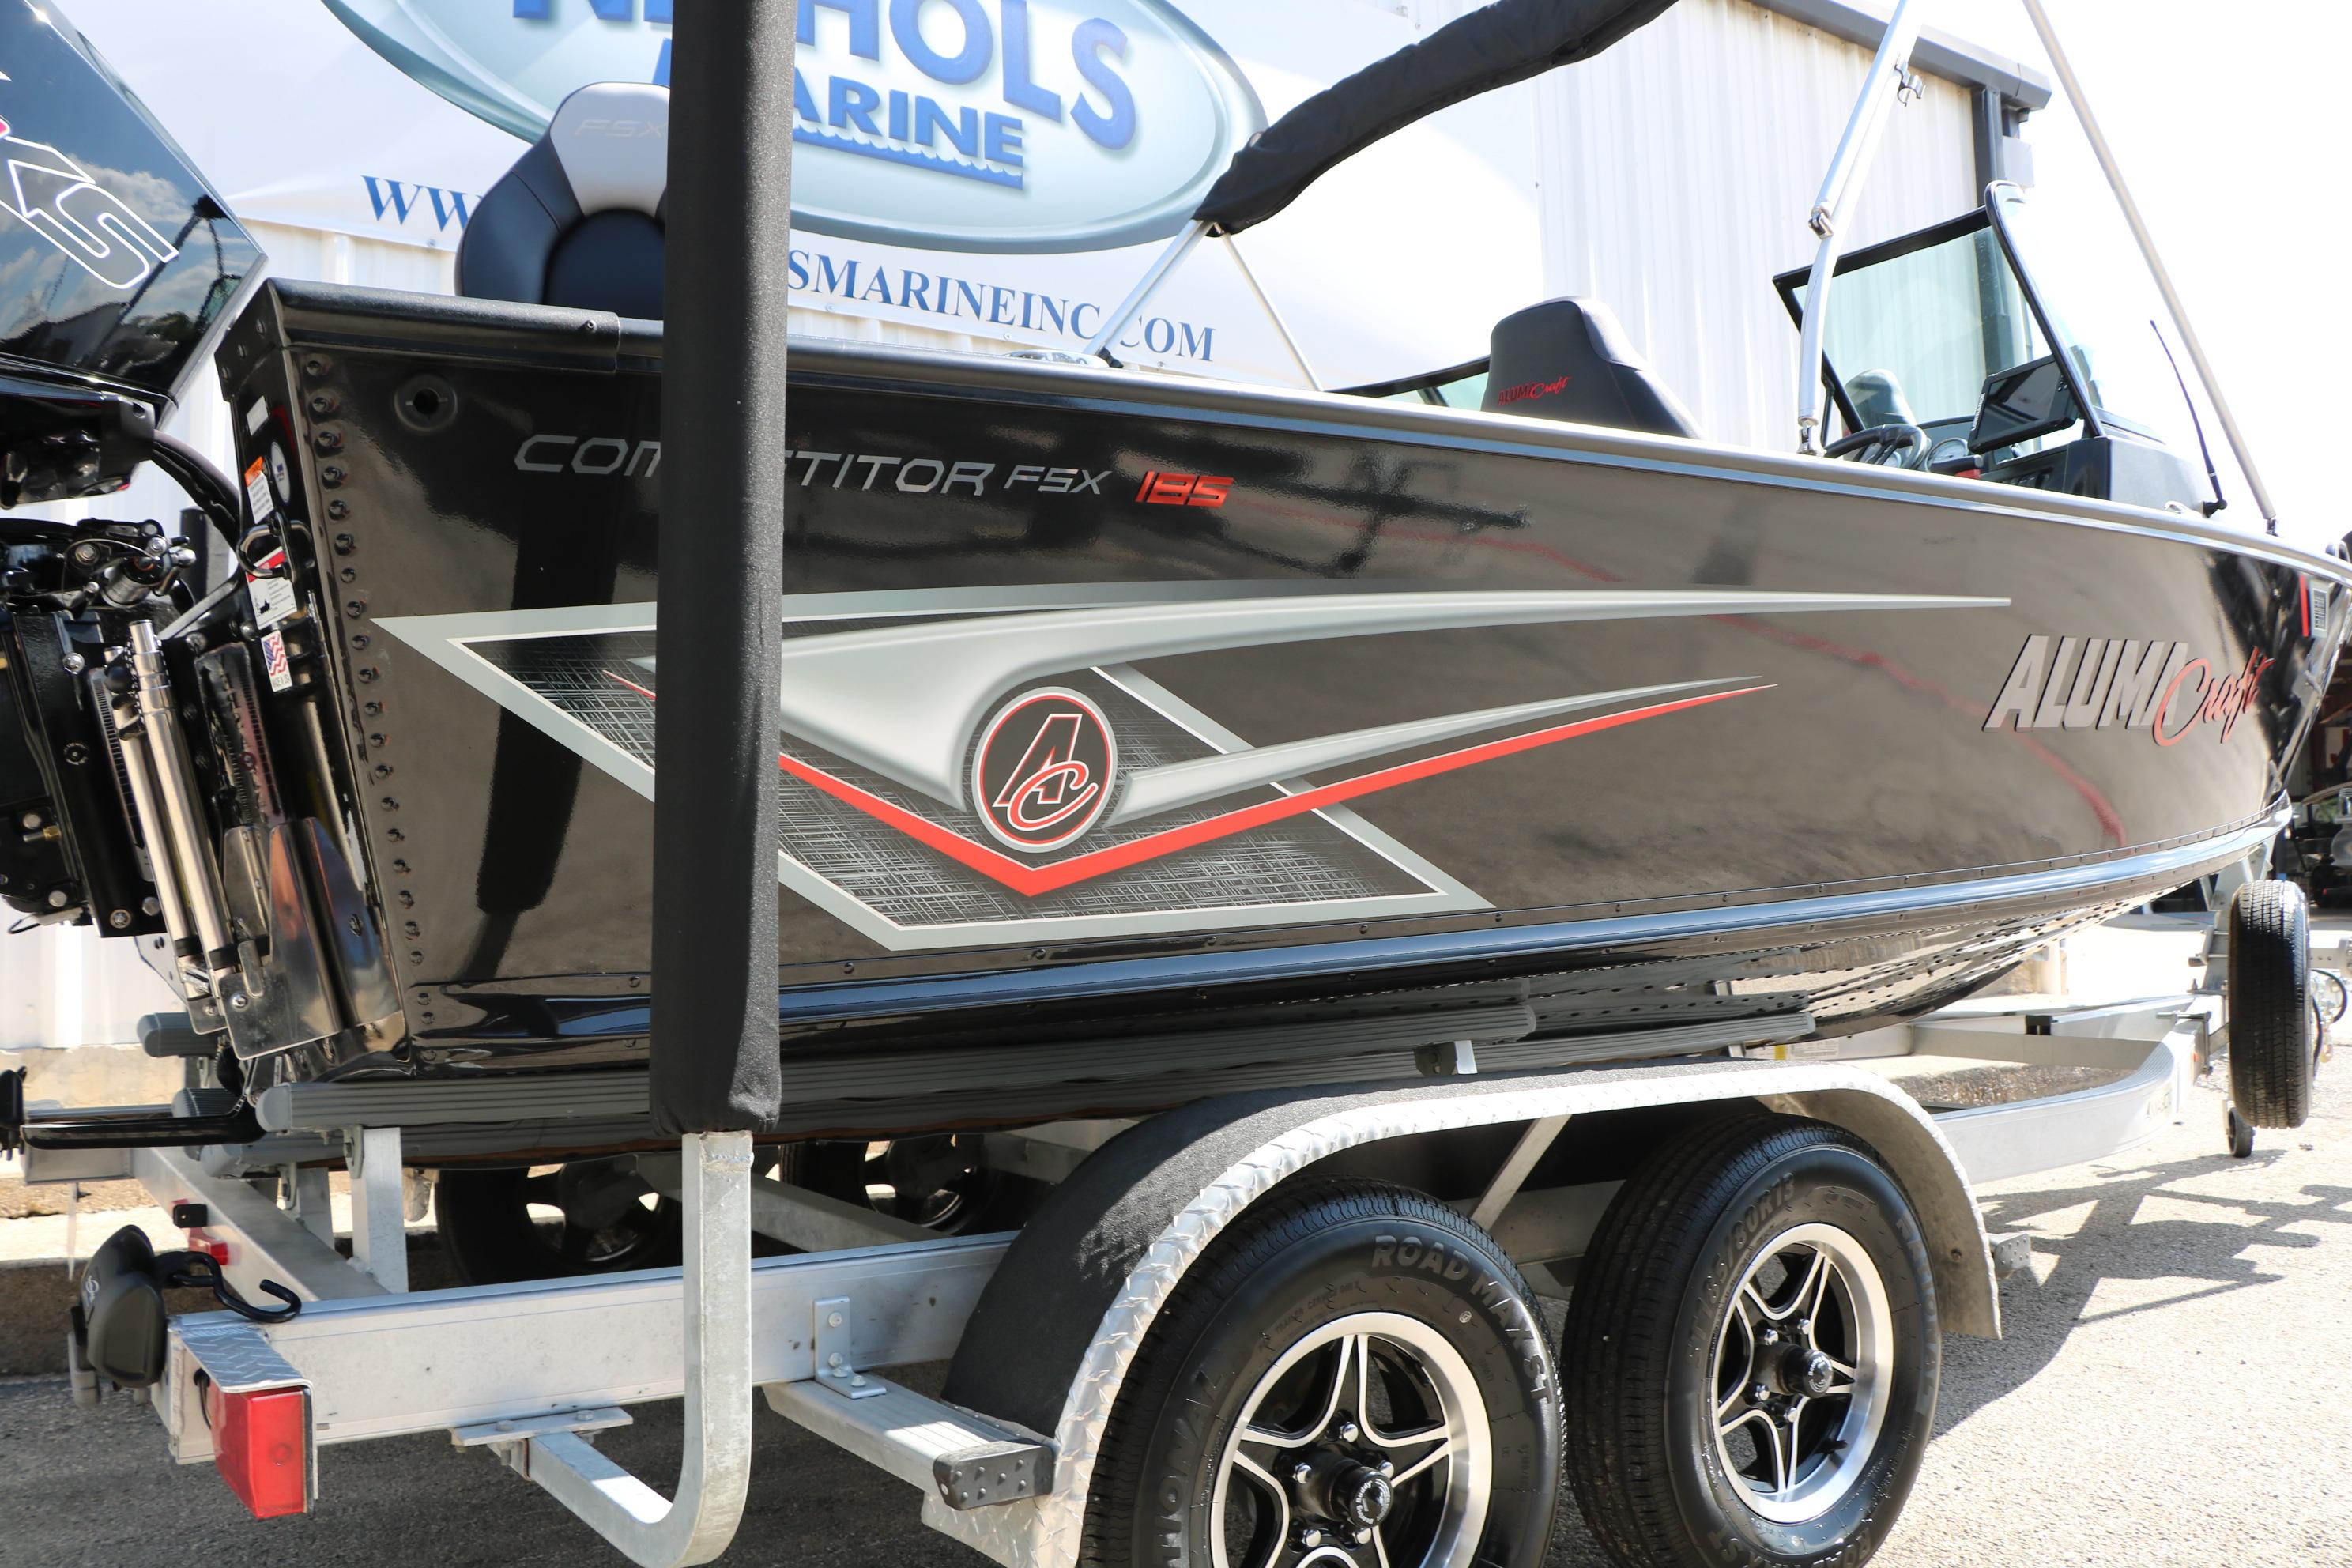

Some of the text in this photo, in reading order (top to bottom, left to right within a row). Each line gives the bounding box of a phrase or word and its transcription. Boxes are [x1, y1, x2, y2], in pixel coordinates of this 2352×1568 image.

[1003, 464, 1113, 496] FSX
[1134, 469, 1235, 509] 185
[1371, 1234, 1470, 1280] ROAD
